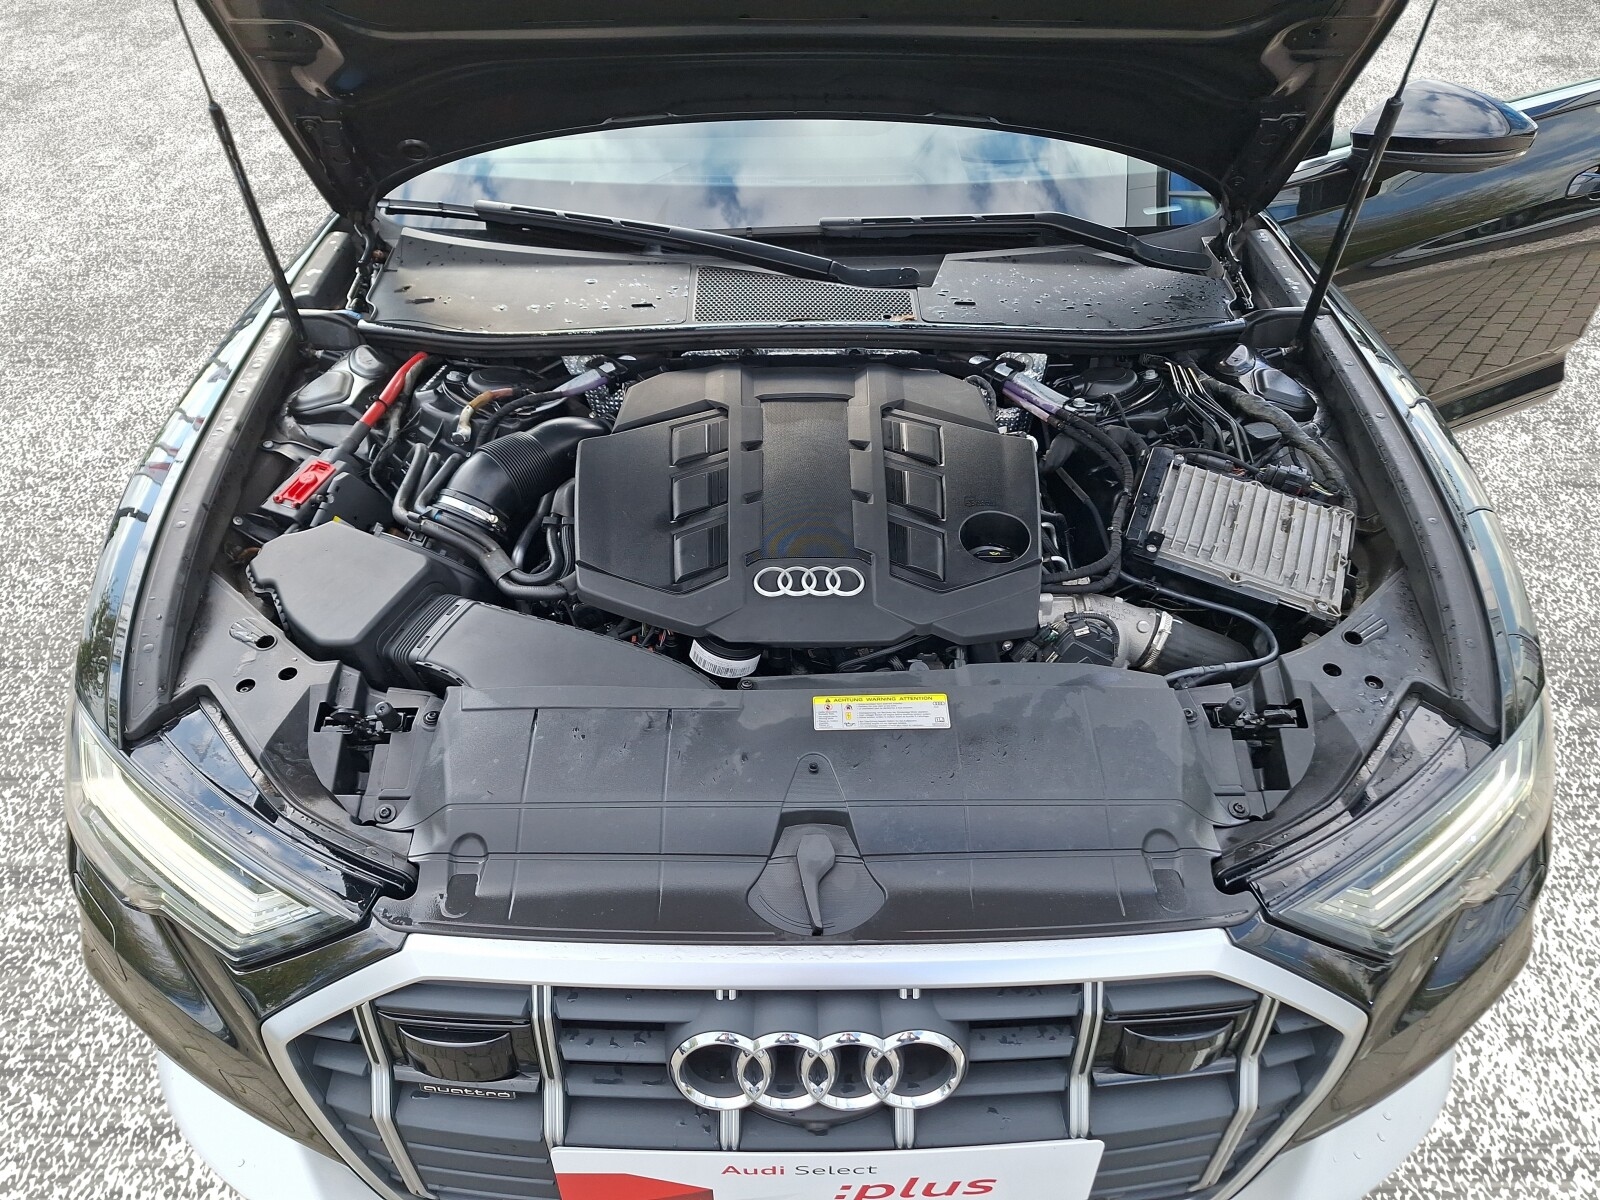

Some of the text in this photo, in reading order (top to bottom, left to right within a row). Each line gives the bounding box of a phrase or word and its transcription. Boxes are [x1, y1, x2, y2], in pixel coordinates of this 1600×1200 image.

[423, 1085, 511, 1098] quattro
[721, 1165, 878, 1175] Audi Select
